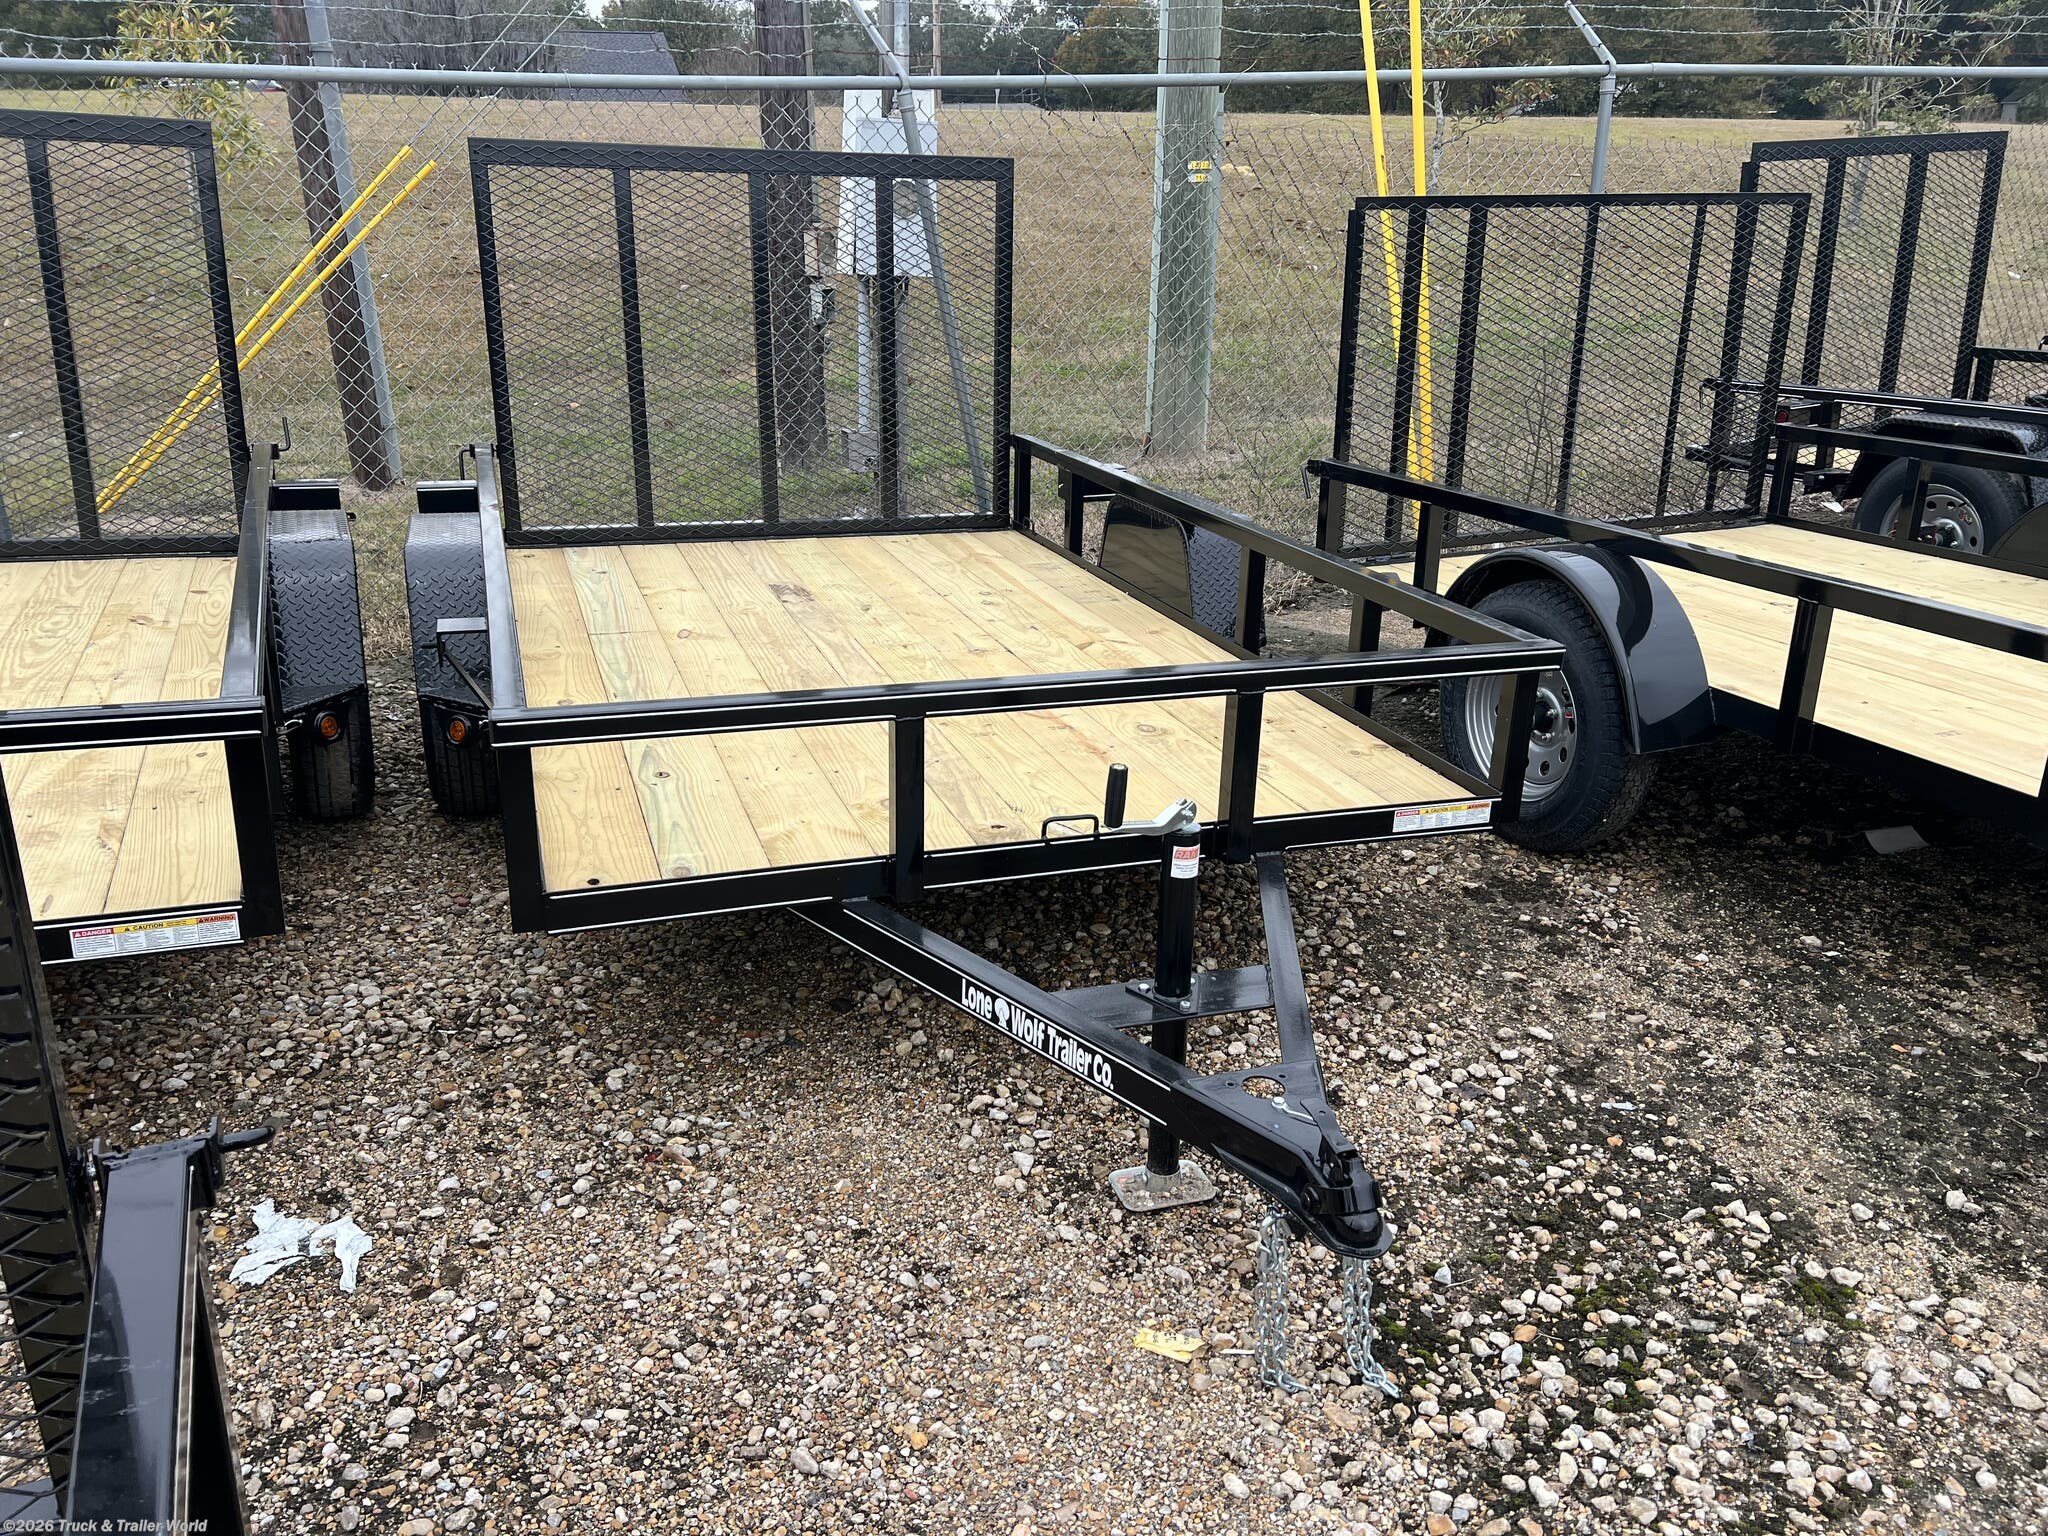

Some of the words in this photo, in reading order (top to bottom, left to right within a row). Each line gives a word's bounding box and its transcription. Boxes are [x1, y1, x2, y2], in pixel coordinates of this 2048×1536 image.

[82, 928, 112, 937] DANGER
[132, 922, 164, 931] CAUTION
[203, 914, 235, 923] WARNING
[961, 978, 993, 1019] Lone
[1010, 1004, 1046, 1050] Wolf
[1047, 1025, 1093, 1077] Trailer
[1093, 1053, 1114, 1090] Co.
